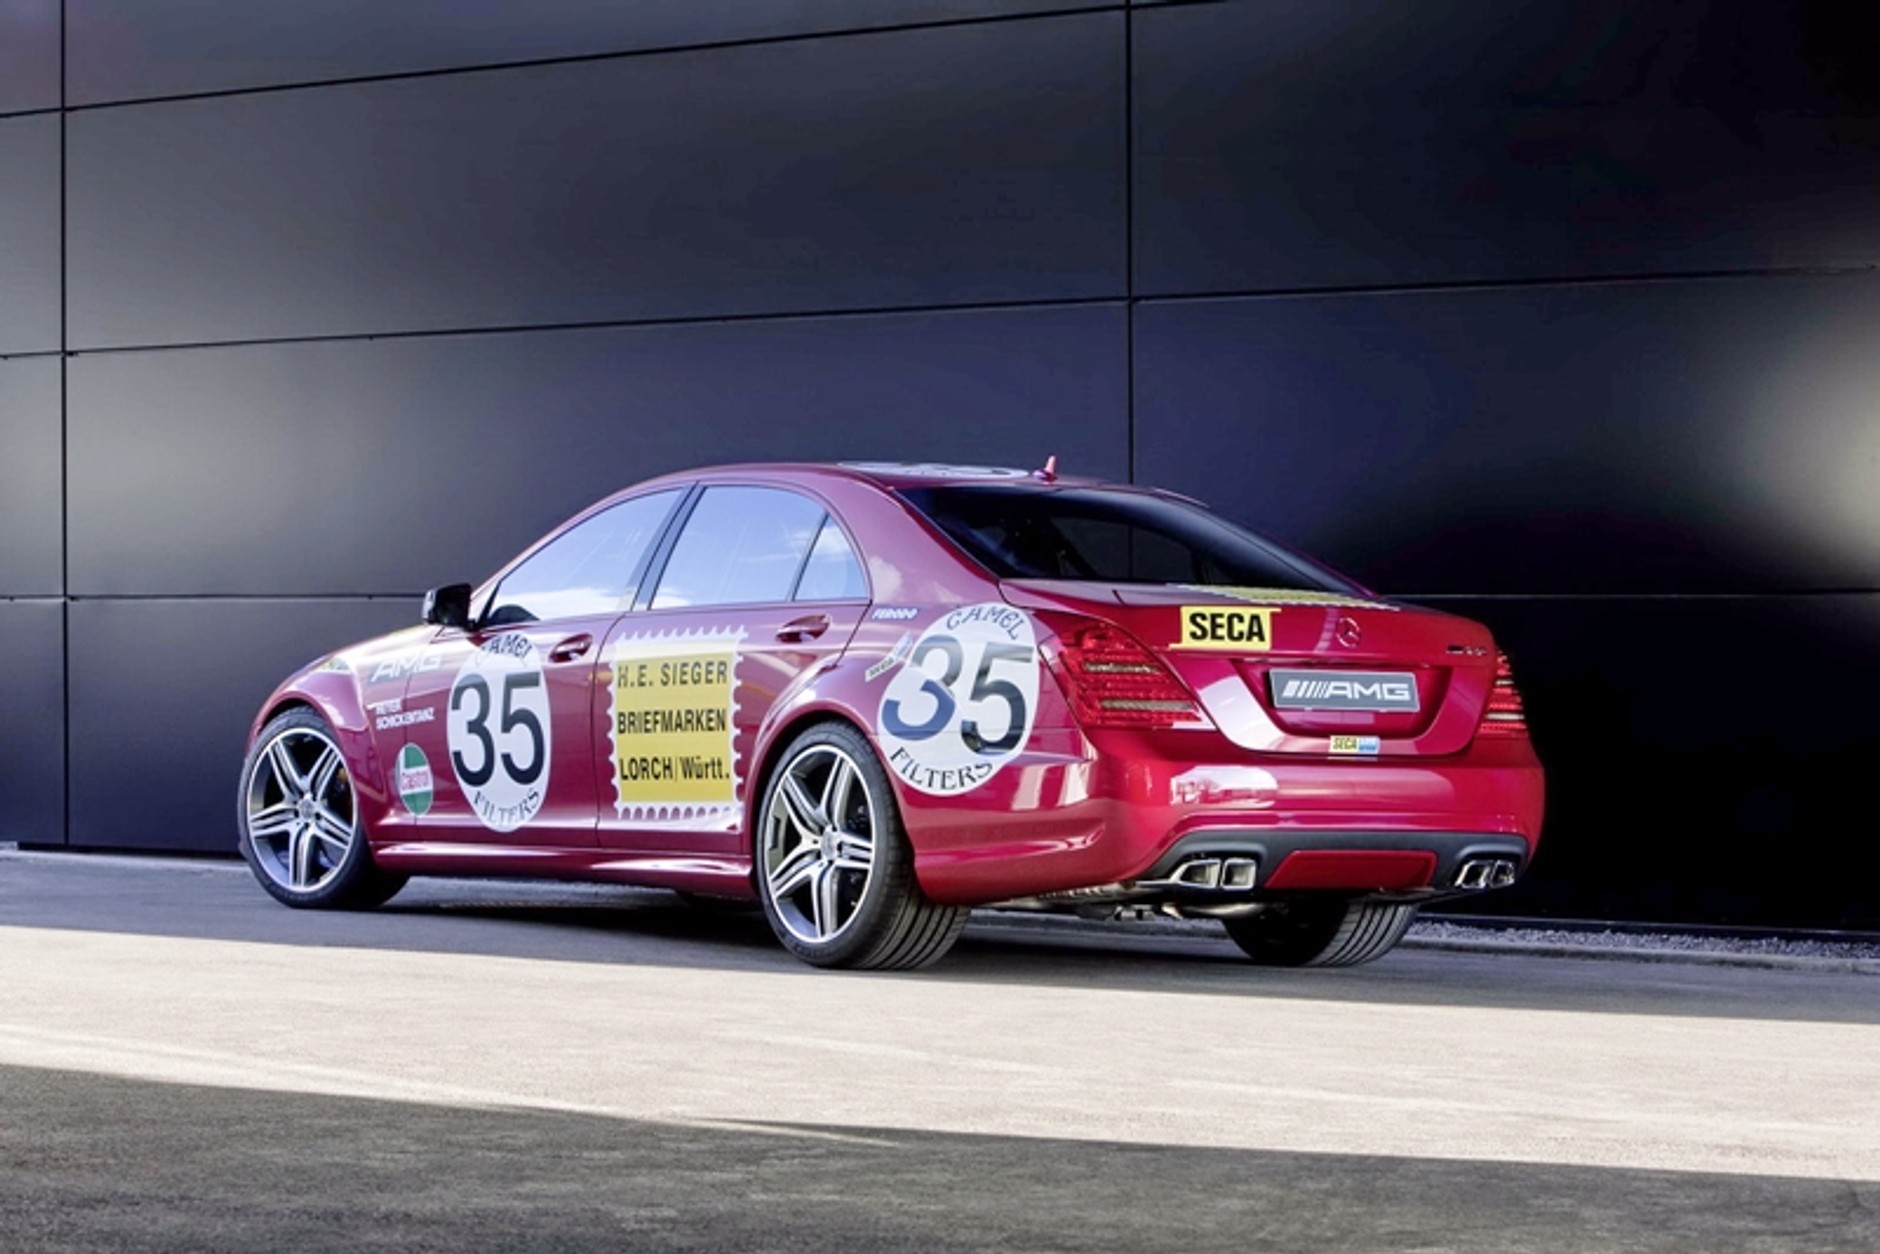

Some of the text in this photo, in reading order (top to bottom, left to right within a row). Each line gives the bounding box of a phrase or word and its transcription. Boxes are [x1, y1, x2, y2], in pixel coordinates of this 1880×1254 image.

[947, 606, 1025, 640] CAMEL
[1189, 612, 1266, 642] SECA
[617, 660, 728, 688] H.E. SIEGER
[881, 634, 1035, 757] 35
[451, 670, 545, 788] 35
[617, 708, 727, 734] BRIEFMARKEN
[1332, 737, 1357, 750] SECA
[890, 746, 993, 790] FILTERS
[474, 787, 540, 825] FILTERS
